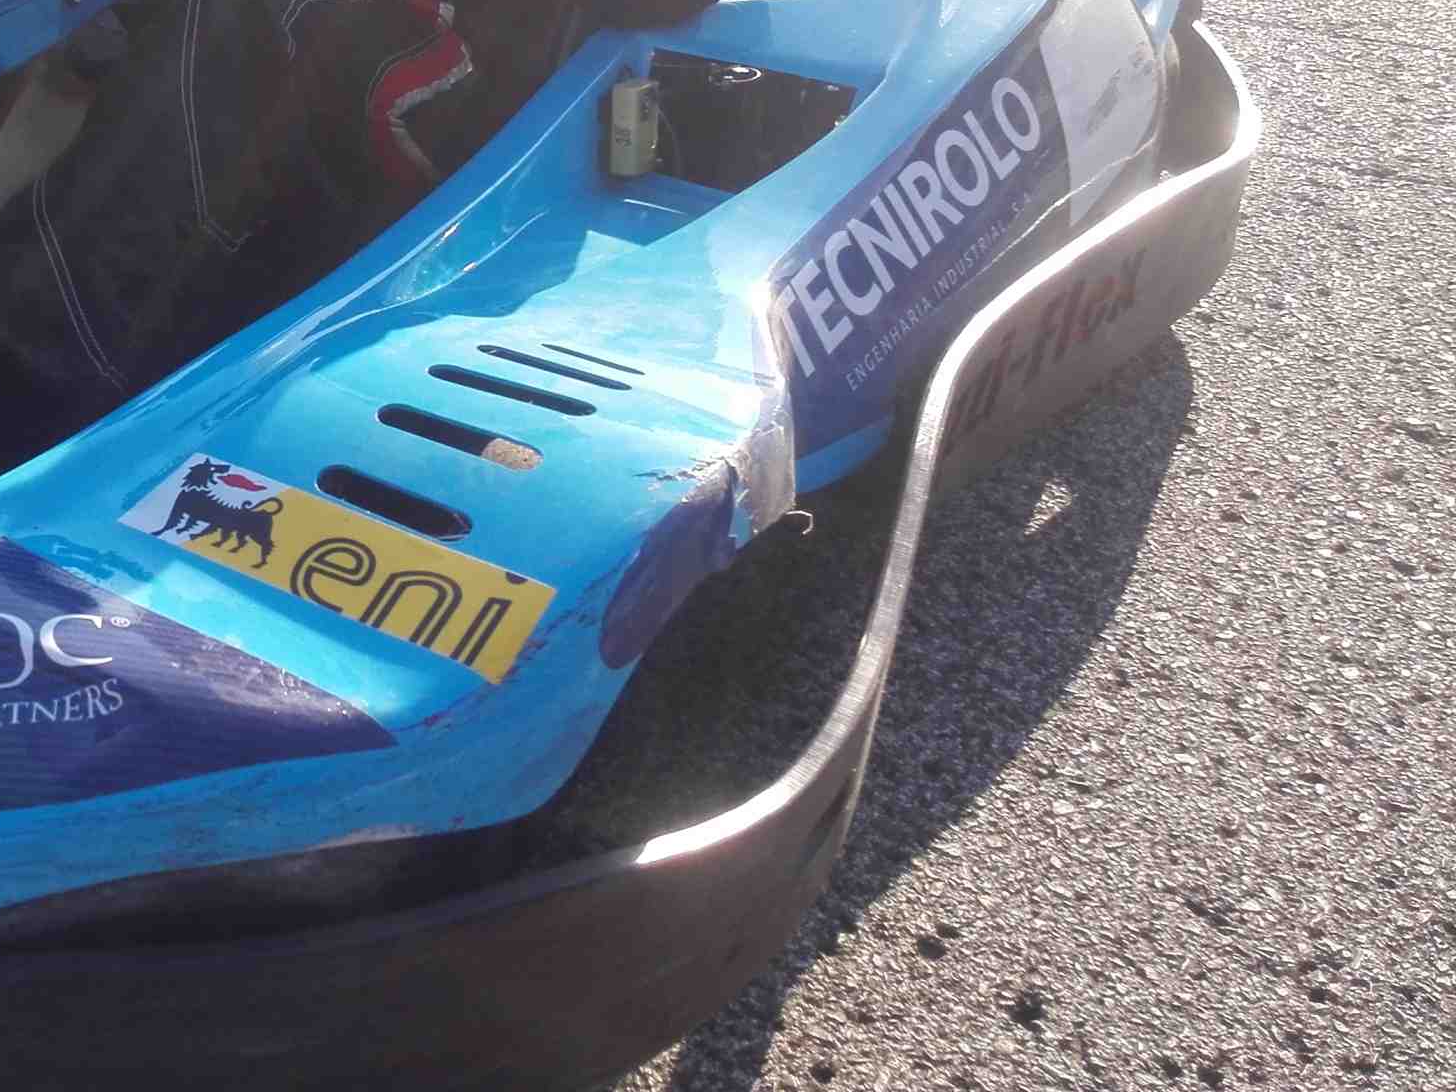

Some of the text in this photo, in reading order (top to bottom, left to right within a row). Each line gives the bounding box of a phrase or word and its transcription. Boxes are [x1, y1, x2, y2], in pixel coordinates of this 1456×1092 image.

[775, 77, 1041, 379] TECNIROLO
[845, 297, 933, 393] ENGENHARIA
[290, 537, 529, 666] eni
